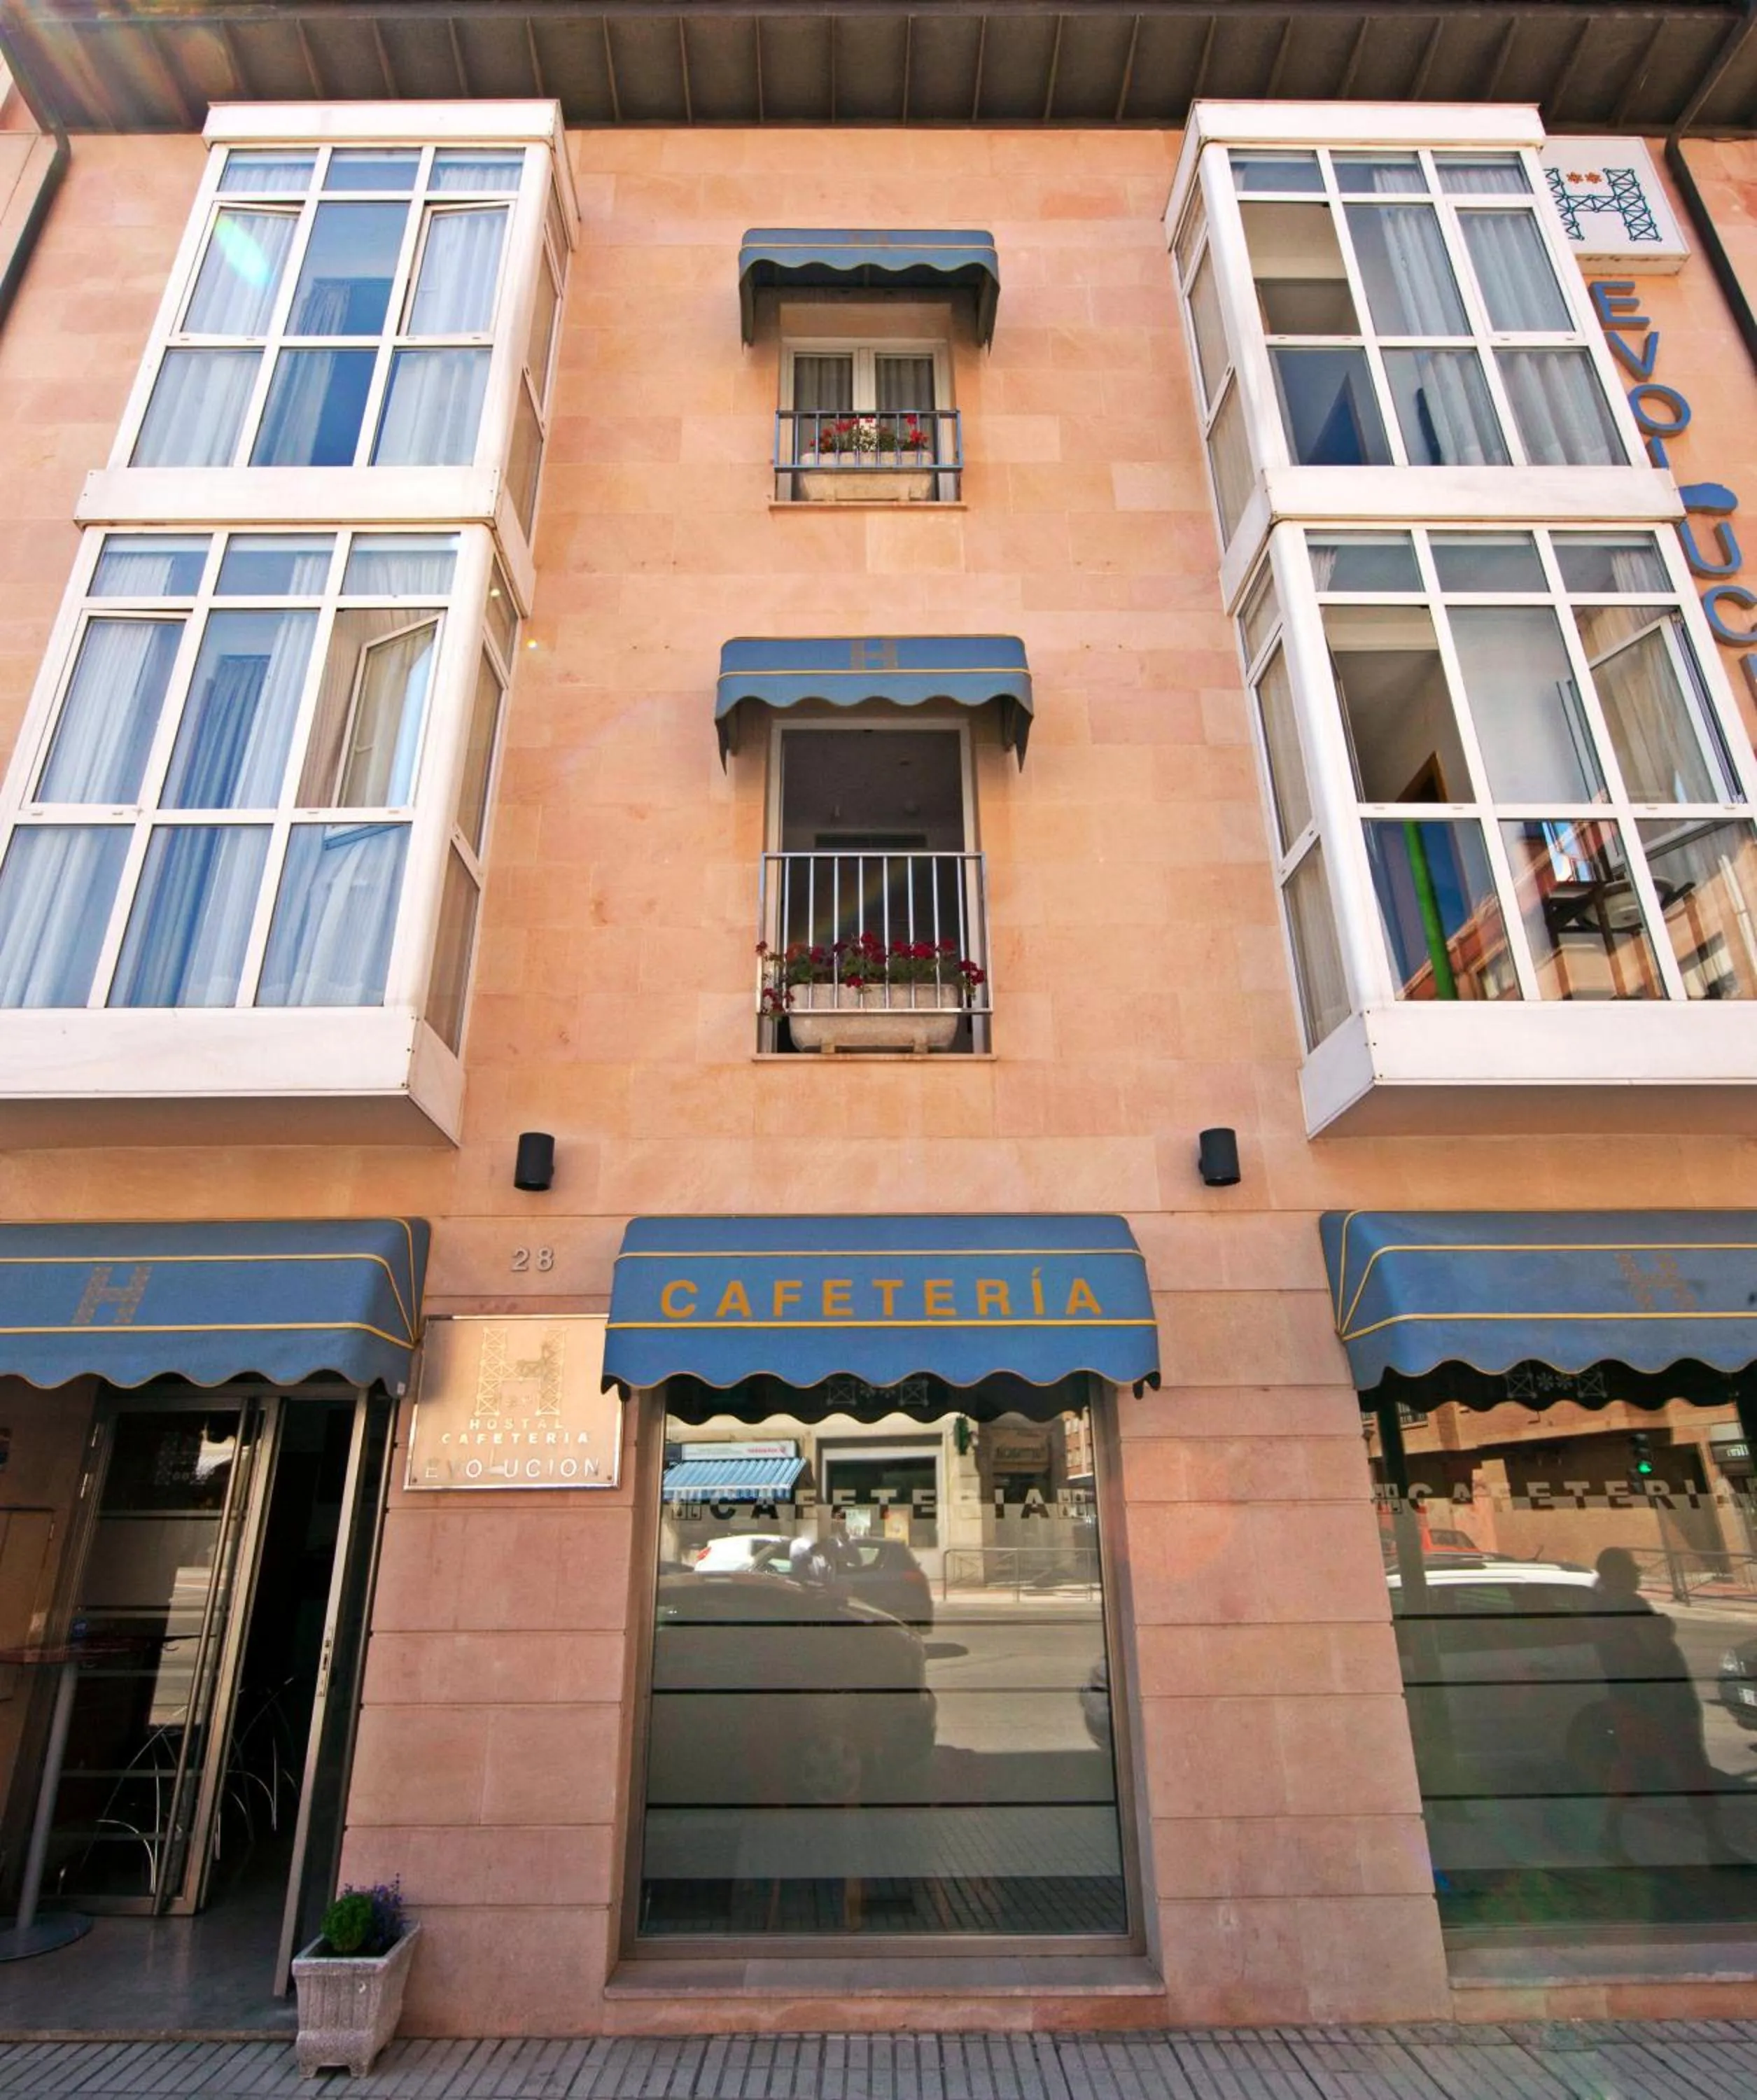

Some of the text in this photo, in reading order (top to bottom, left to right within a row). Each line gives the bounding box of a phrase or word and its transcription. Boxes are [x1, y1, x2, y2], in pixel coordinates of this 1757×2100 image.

[511, 1247, 554, 1272] 28
[660, 1266, 1102, 1319] CAFETERÍA
[470, 1418, 564, 1431] HOSTAL
[441, 1432, 592, 1445] CAFETERIA
[1407, 1479, 1744, 1514] CAETERI
